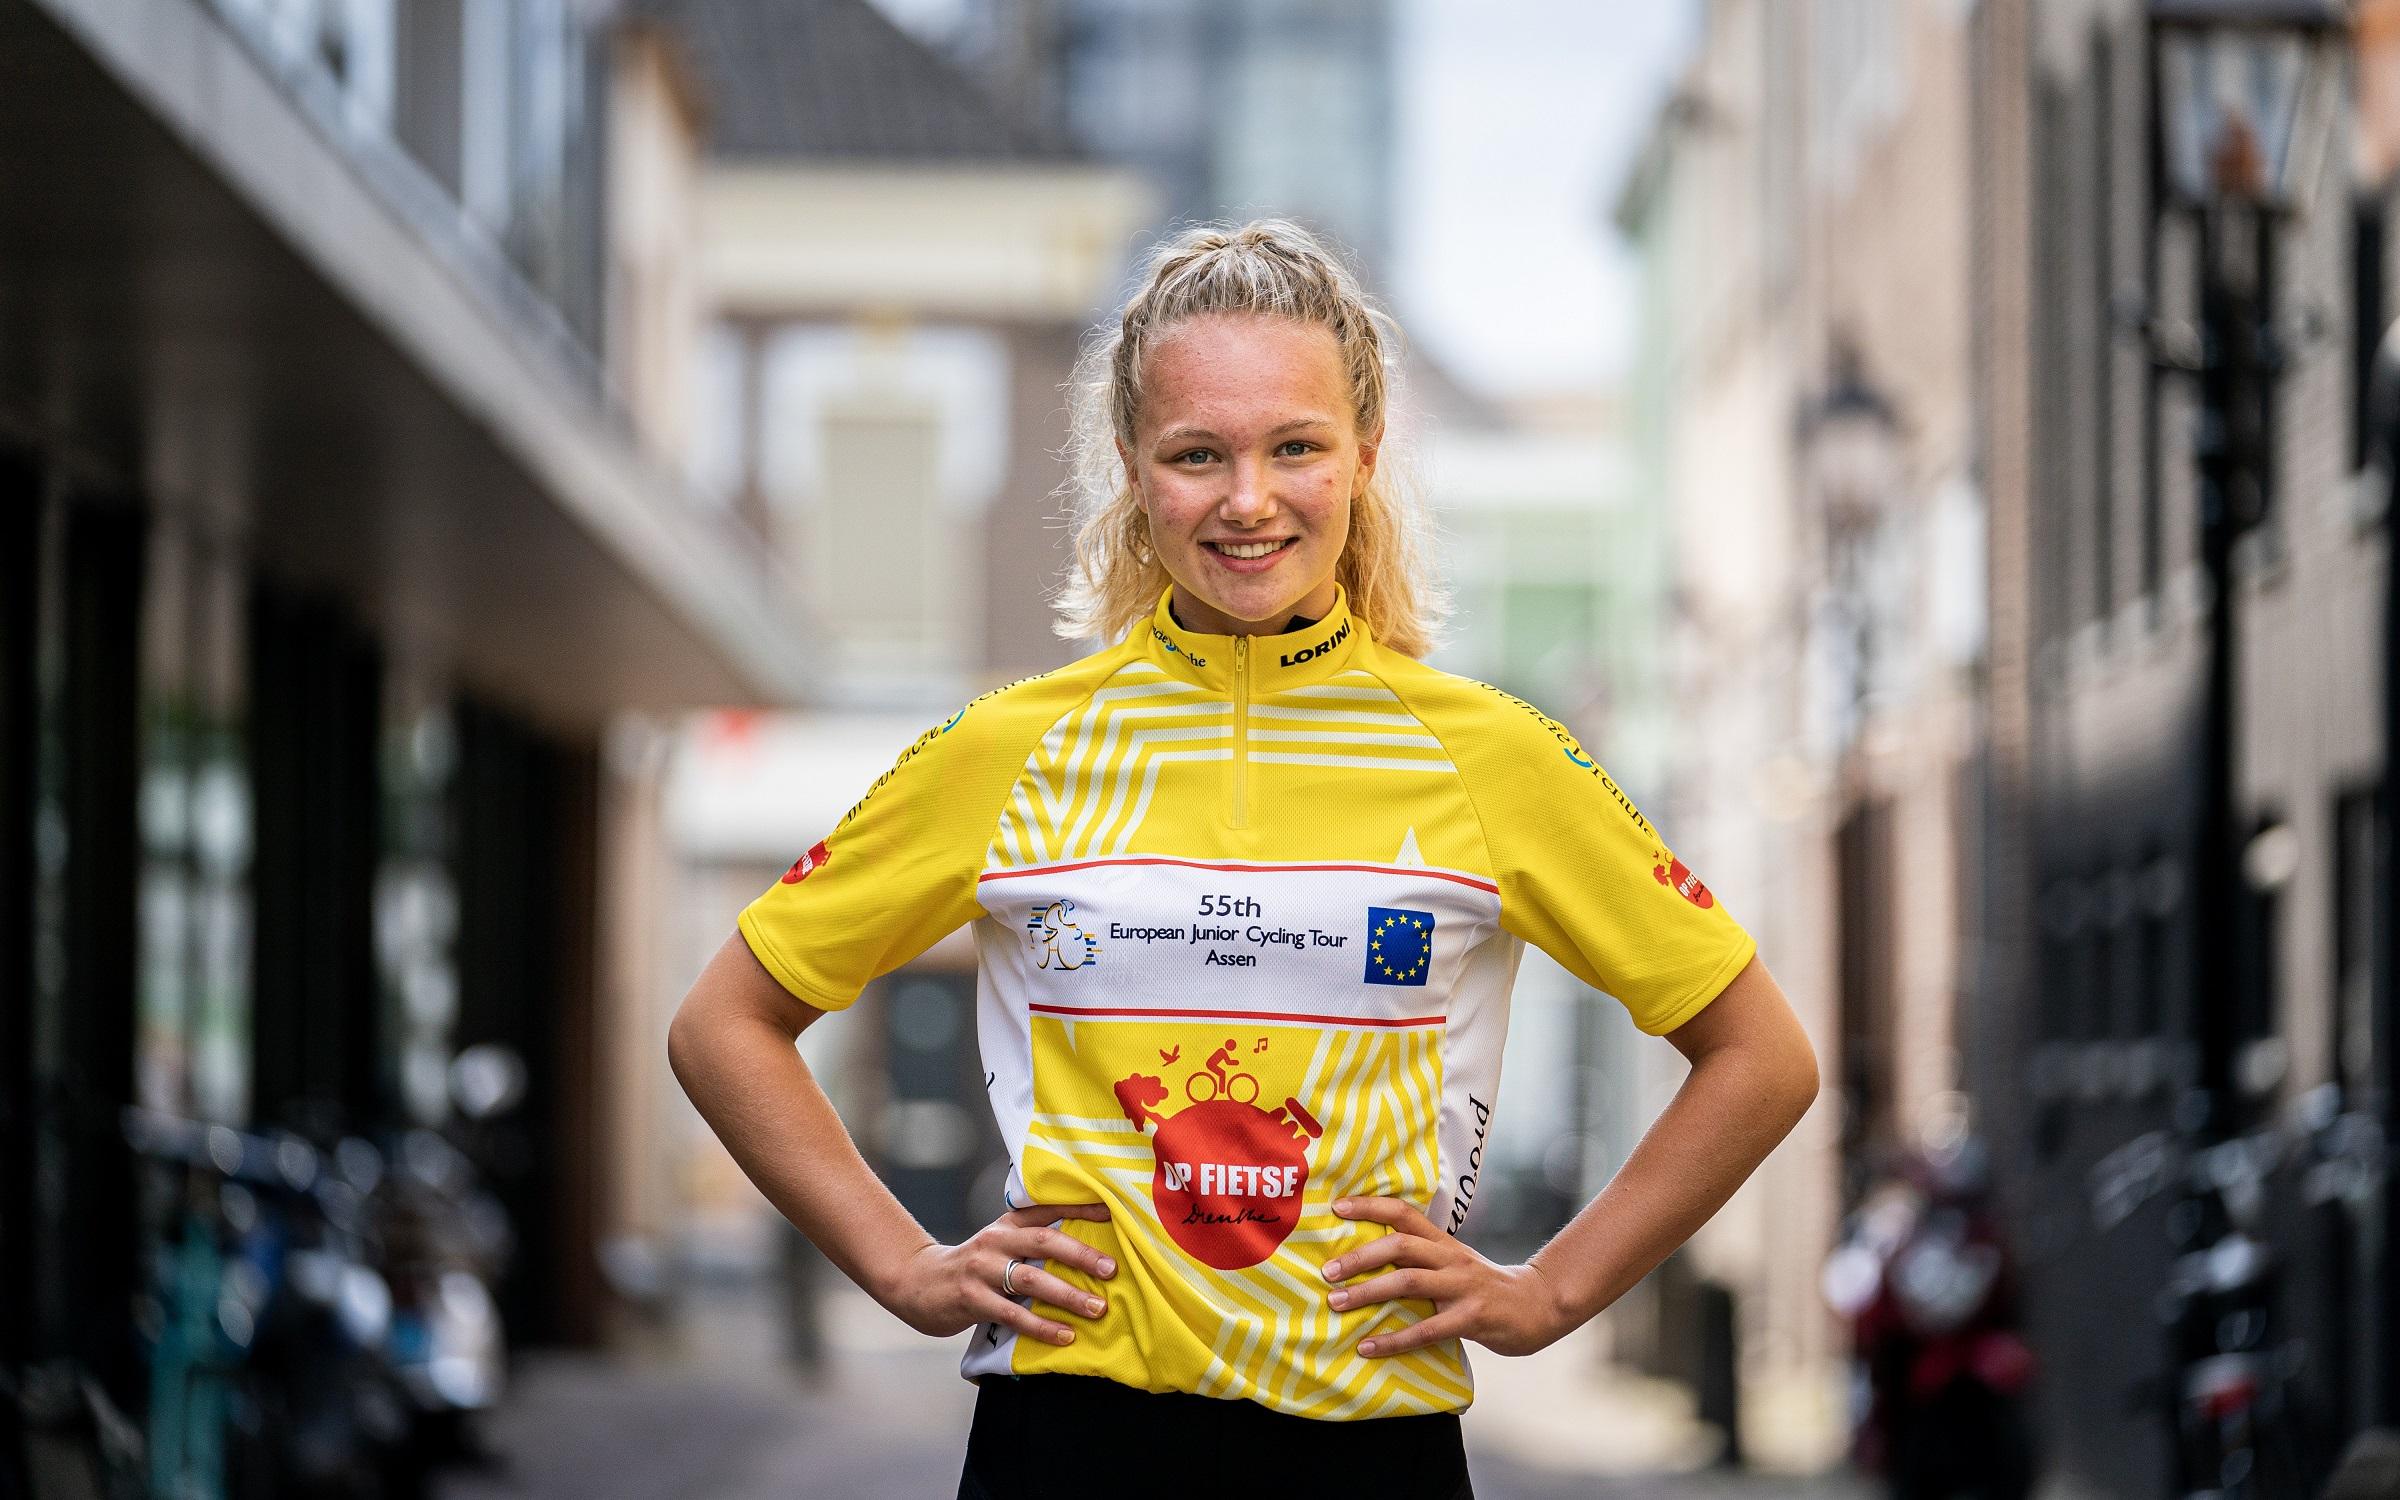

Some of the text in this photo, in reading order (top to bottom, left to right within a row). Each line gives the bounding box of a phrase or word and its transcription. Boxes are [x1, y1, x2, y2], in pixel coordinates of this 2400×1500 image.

[1198, 894, 1261, 918] 55th
[1110, 922, 1348, 950] European Junior Cycling Tour
[1205, 949, 1257, 968] Assen
[1446, 1093, 1490, 1237] provin
[1200, 1162, 1299, 1199] FIETSE
[1183, 1203, 1281, 1225] Drenthe
